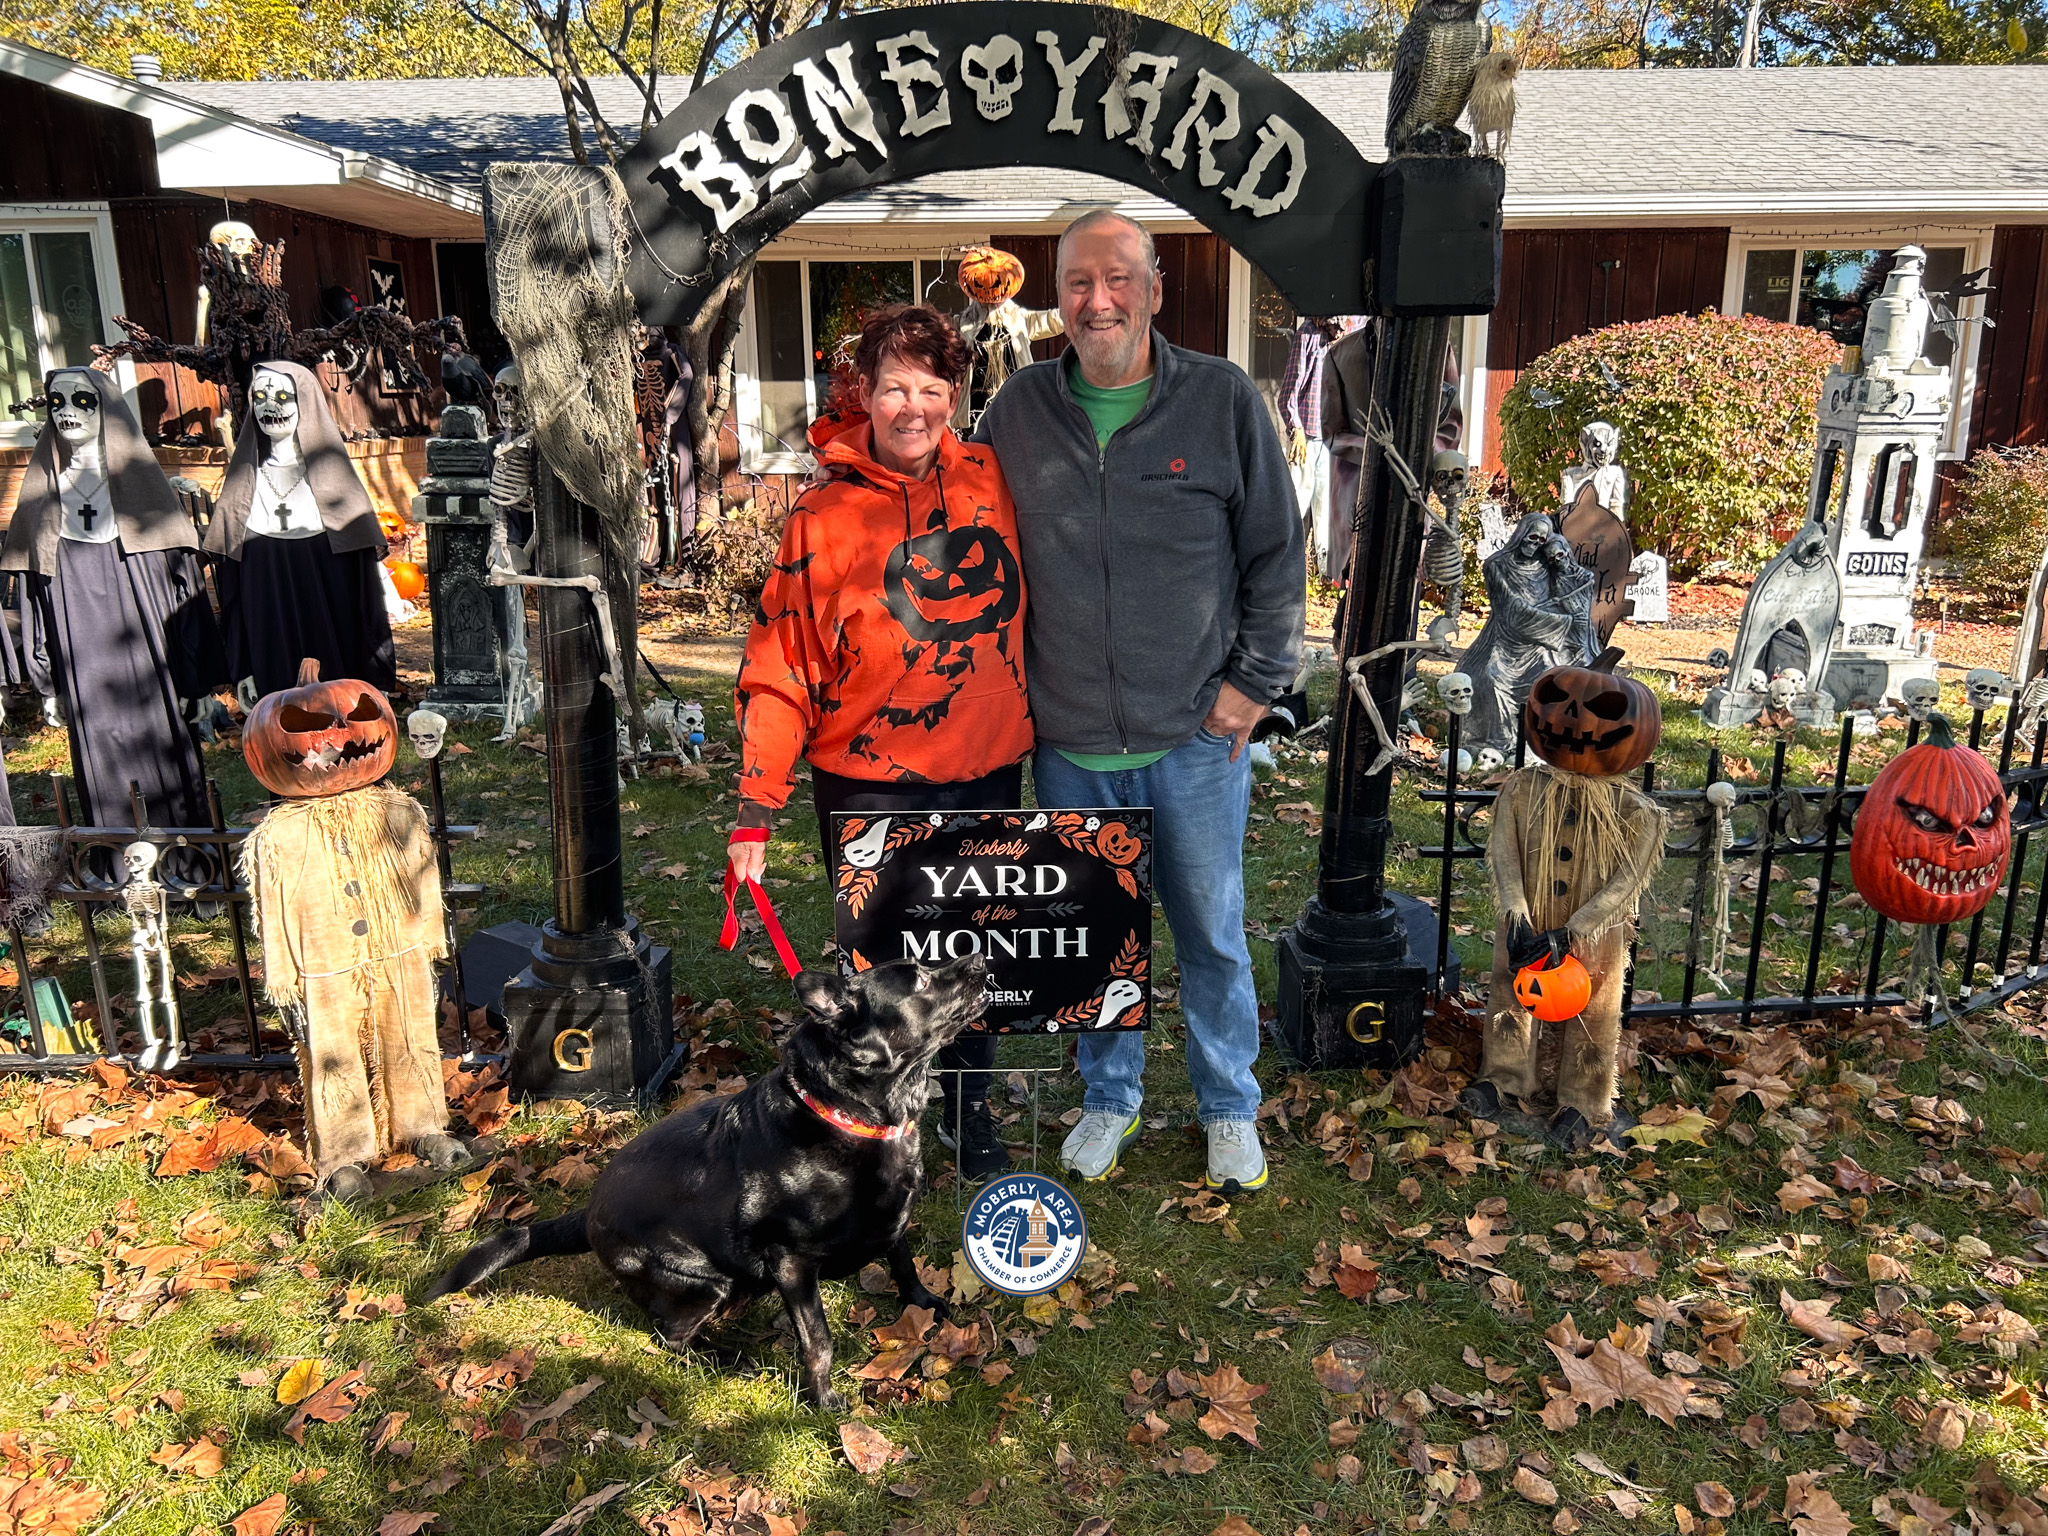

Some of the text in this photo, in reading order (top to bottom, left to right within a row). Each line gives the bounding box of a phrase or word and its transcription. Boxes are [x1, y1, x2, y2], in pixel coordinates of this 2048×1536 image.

[657, 29, 1307, 234] BONE YARD
[1767, 277, 1811, 288] LIGT
[1847, 553, 1906, 574] GOINS
[1627, 585, 1661, 597] BROOKE
[453, 633, 486, 651] RIP
[958, 838, 1030, 861] Moberly
[920, 865, 1067, 898] YARD
[971, 904, 1018, 926] of the
[901, 927, 1089, 961] MONTH
[987, 989, 1033, 1003] BERLY
[1346, 1001, 1386, 1043] G
[553, 1027, 594, 1072] G
